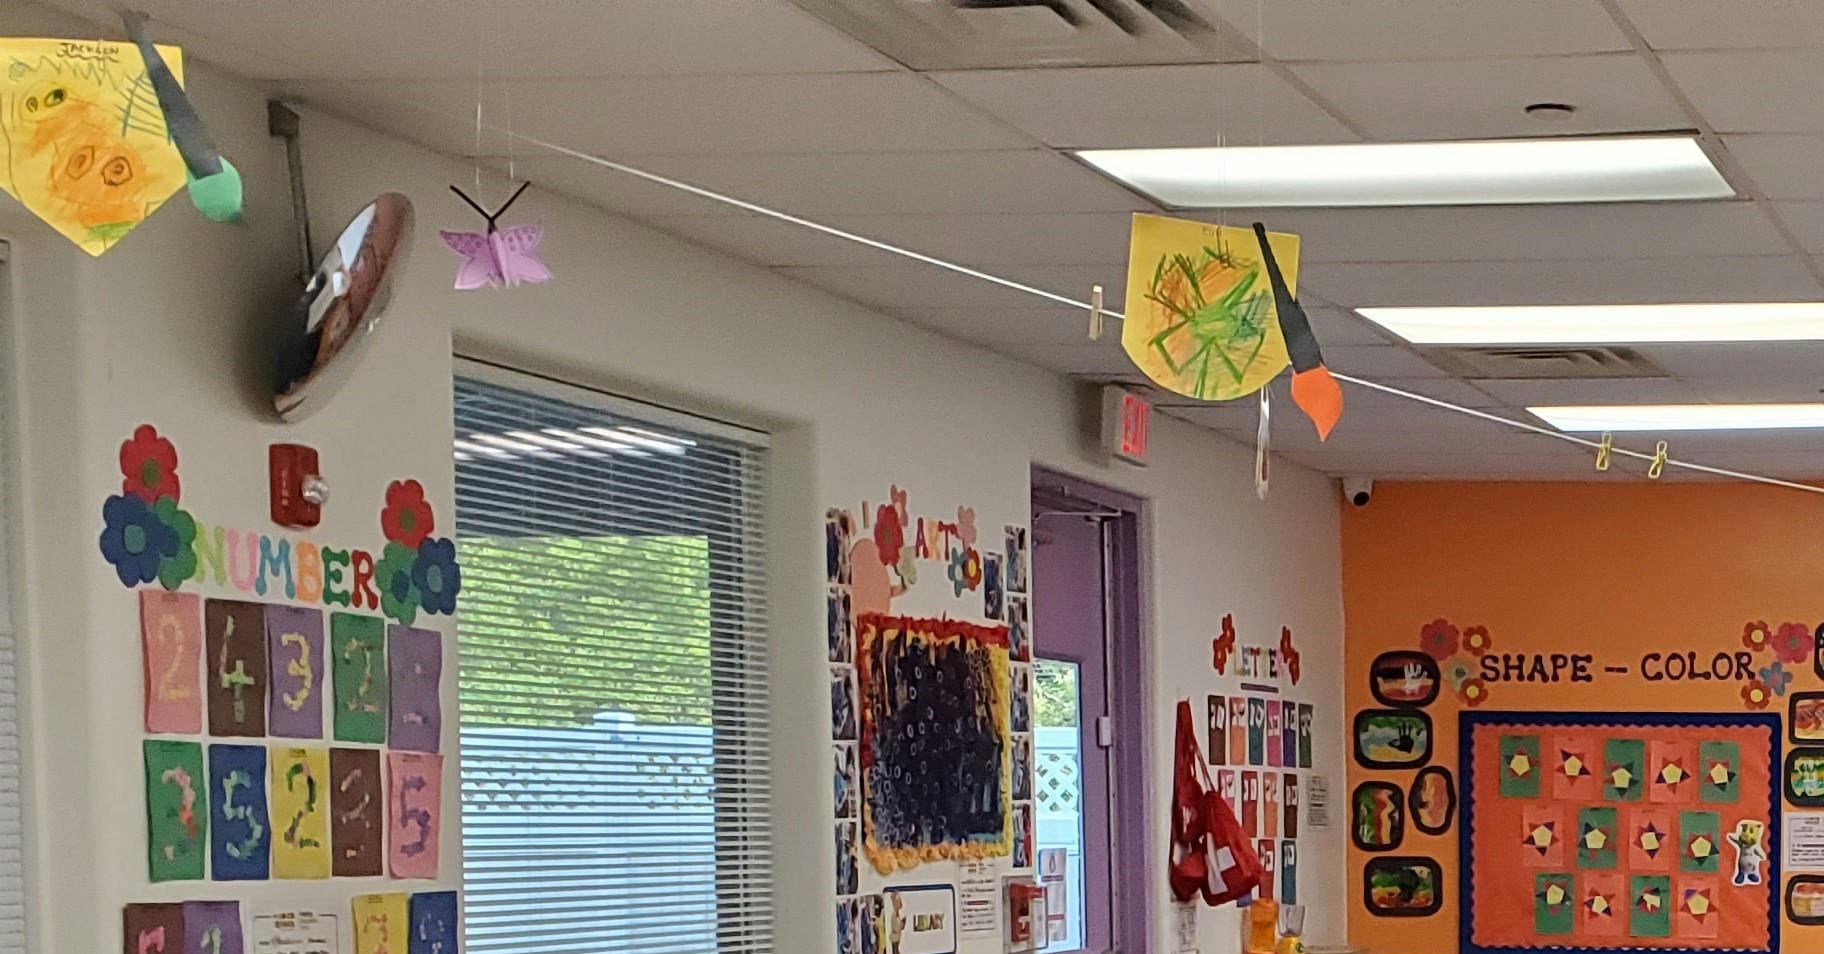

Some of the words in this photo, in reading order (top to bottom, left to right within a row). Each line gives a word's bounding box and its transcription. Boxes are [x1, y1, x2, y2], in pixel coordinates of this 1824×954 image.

[195, 521, 379, 611] NUMBER
[915, 517, 958, 561] ART
[158, 613, 190, 700] 2
[220, 615, 255, 723] 4
[281, 632, 313, 711] 3
[1480, 654, 1593, 683] SHAPE
[1641, 652, 1755, 681] COLOR
[222, 769, 263, 860] 5
[284, 761, 320, 849] 2
[401, 776, 431, 855] 5
